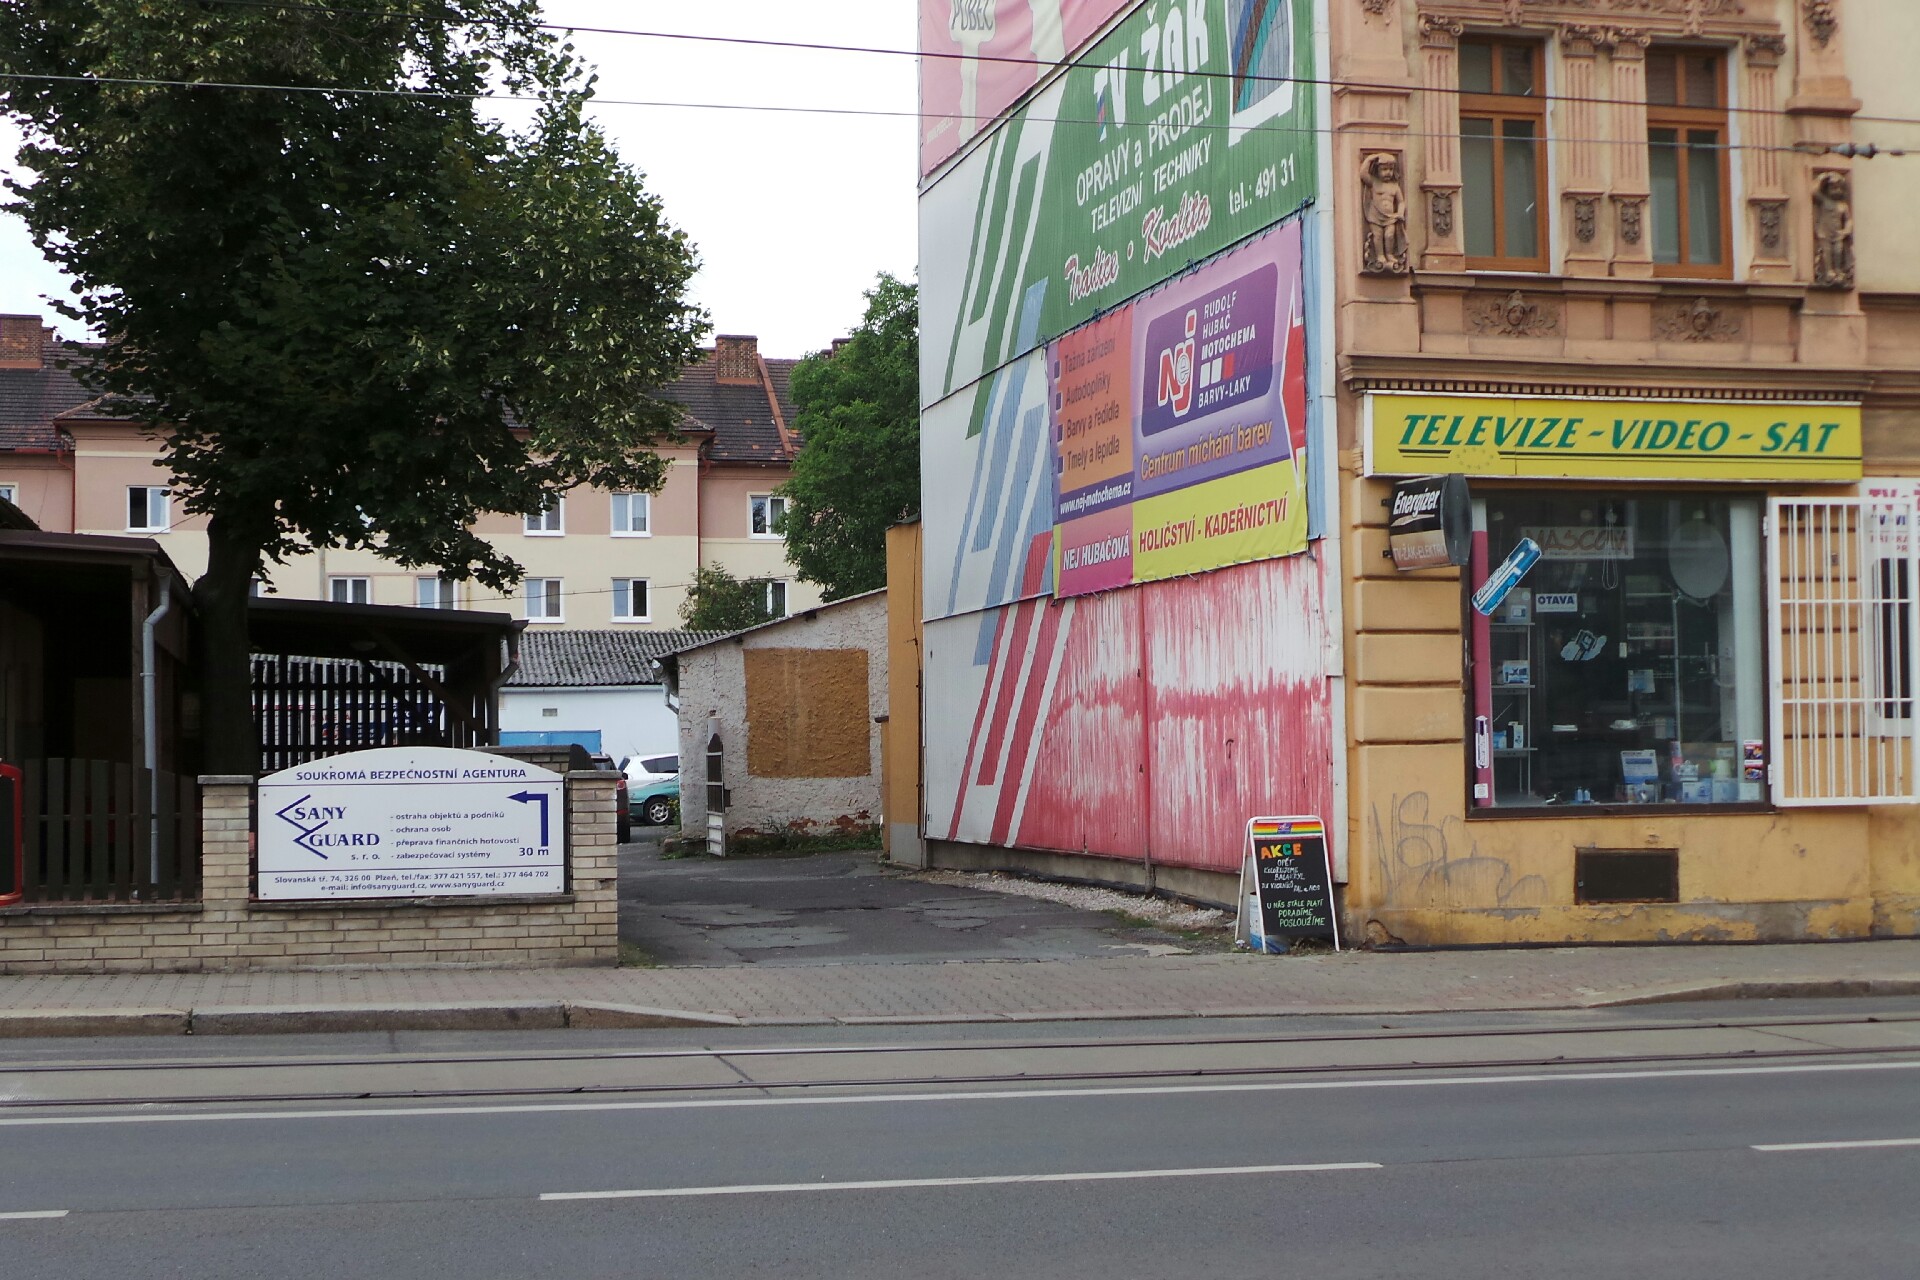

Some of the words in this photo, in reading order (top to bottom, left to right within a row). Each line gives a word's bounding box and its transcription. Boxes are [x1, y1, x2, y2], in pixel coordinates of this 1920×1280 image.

[1094, 47, 1129, 142] TV
[1077, 138, 1130, 206] OPRAVY
[1134, 140, 1142, 168] a
[1148, 78, 1212, 157] PRODEJ
[1091, 172, 1143, 233] TELEVIZNÍ
[1153, 133, 1212, 195] TECHNIKY
[1229, 182, 1252, 215] tel.:
[1255, 164, 1276, 198] 491
[1280, 153, 1295, 187] 31
[1065, 245, 1120, 306] Tradice
[1142, 190, 1211, 264] Kvalita
[1204, 290, 1237, 319] RUDOLF
[1202, 309, 1231, 339] HUBAČ
[1201, 324, 1256, 360] MOTOCHEMA
[1198, 375, 1251, 408] BARVY-LAKY
[1067, 418, 1087, 439] Barvy
[1088, 415, 1092, 430] a
[1399, 414, 1584, 448] TELEVIZE
[1611, 419, 1730, 451] VIDEO
[1760, 422, 1840, 453] SAT
[1067, 447, 1088, 471] Tmely
[1089, 447, 1094, 463] a
[1095, 434, 1120, 464] lepidla
[1141, 451, 1185, 481] Centrum
[1188, 429, 1235, 464] míchání
[1237, 420, 1273, 451] barev
[1060, 482, 1131, 515] www.nej-motochema.cz
[1393, 487, 1441, 517] Energizer
[1139, 514, 1196, 553] HOLIČSTVÍ
[1205, 491, 1288, 539] KADEŘNICTVÍ
[1062, 545, 1080, 571] NEJ
[1081, 529, 1130, 565] HUBAČOVÁ
[1538, 595, 1575, 605] OTAVA
[297, 770, 366, 781] SOUKROMÁ
[370, 768, 458, 780] BEZPEČNOSTNÍ
[462, 768, 526, 779] AGENTURA
[294, 806, 347, 820] SANY
[396, 812, 427, 820] ostraha
[430, 812, 462, 821] objektů
[471, 811, 505, 820] podniků
[309, 833, 380, 847] GUARD
[396, 839, 433, 847] přeprava
[435, 837, 478, 845] finančních
[431, 825, 451, 833] osob
[396, 851, 455, 860] zabezpečovací
[457, 851, 491, 859] systémy
[519, 847, 534, 857] 30
[537, 848, 549, 856] m
[1261, 843, 1302, 860] AKCE
[321, 883, 348, 891] e-mail:
[350, 881, 427, 891] info@sanyguard.cz,
[430, 880, 505, 889] www.sanyguard.cz
[330, 875, 342, 883] 74,
[466, 872, 482, 880] 557,
[1266, 902, 1272, 910] U
[1273, 900, 1285, 909] NÁS
[1278, 908, 1314, 918] PORADÍME
[1279, 916, 1326, 928] POSLOUŽÍME
